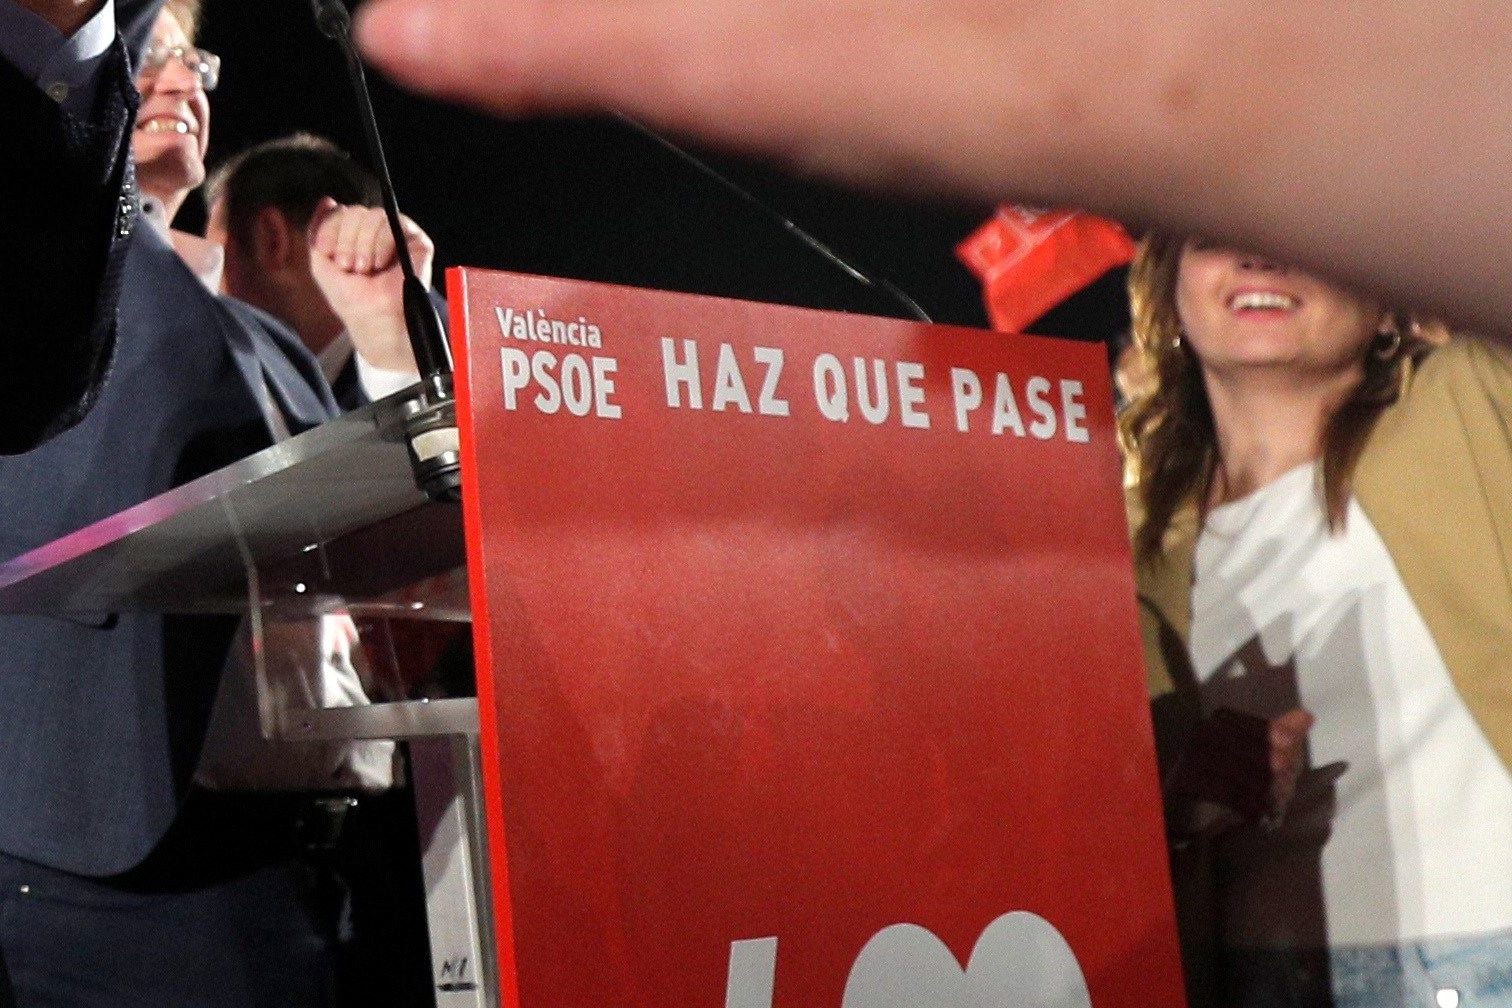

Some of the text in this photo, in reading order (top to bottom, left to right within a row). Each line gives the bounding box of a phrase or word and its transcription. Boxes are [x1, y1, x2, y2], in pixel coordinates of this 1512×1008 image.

[495, 306, 602, 349] València
[500, 347, 622, 420] PSOE
[661, 336, 1090, 443] HAZ QUE PASE
